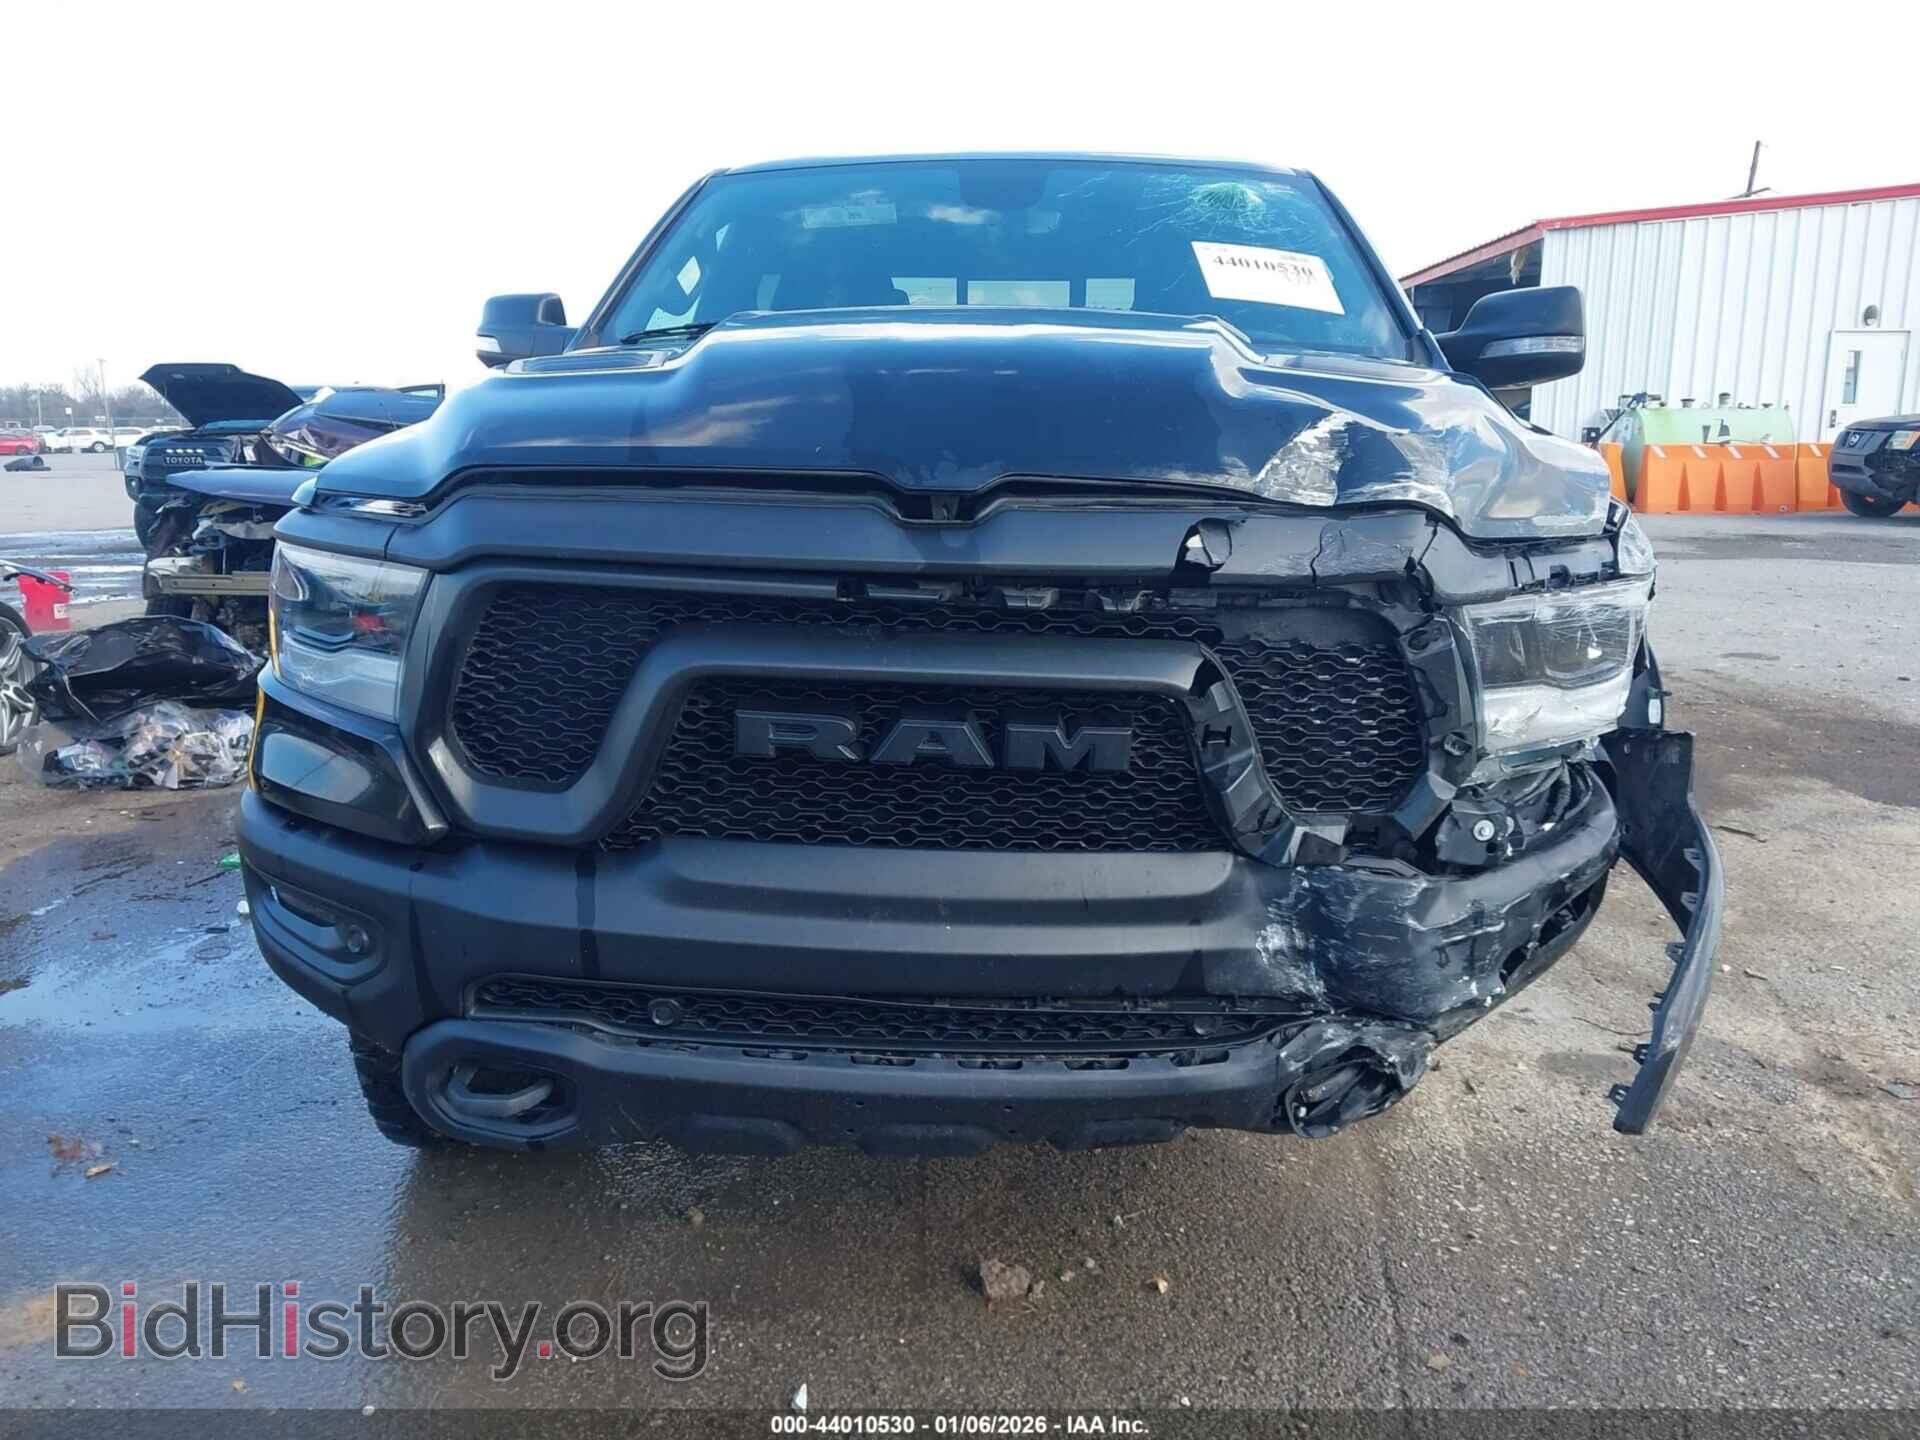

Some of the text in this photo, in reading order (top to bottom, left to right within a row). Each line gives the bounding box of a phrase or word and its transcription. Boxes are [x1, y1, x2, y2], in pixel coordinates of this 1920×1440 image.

[1213, 255, 1313, 277] 44010530
[165, 456, 203, 464] TOYOTA
[735, 709, 1133, 771] RAM
